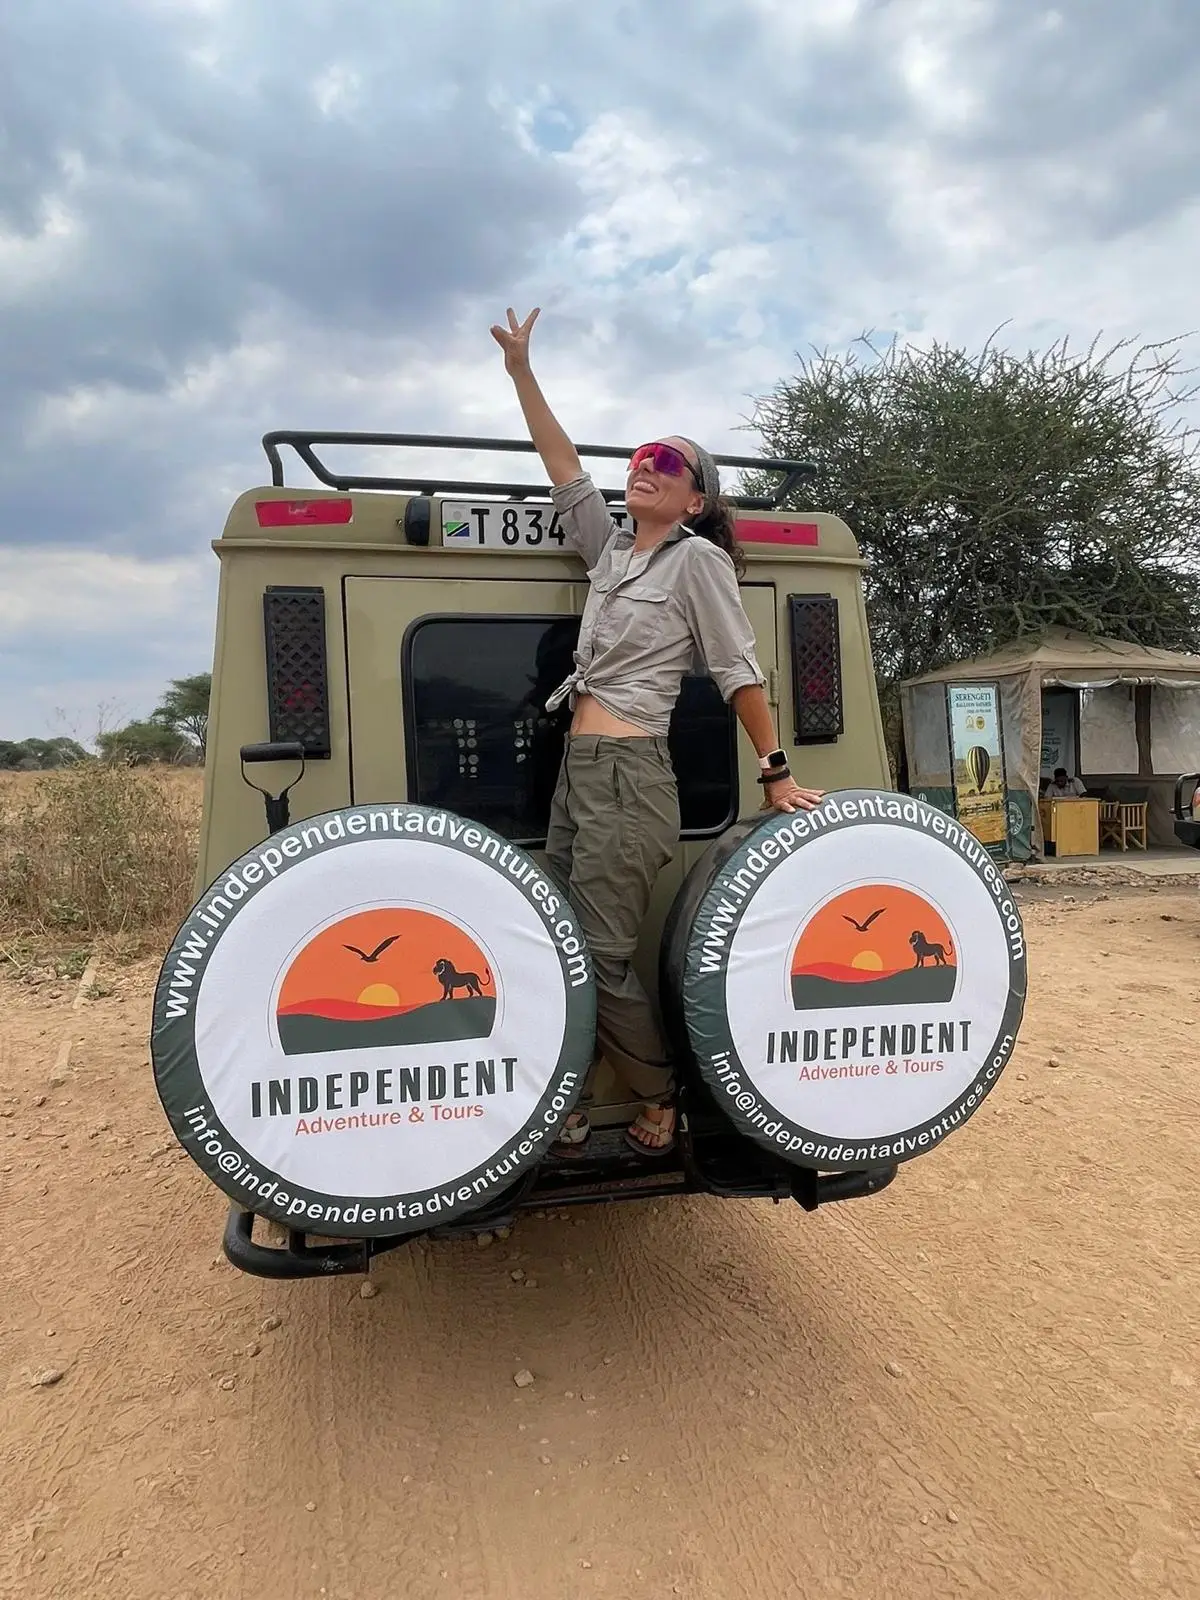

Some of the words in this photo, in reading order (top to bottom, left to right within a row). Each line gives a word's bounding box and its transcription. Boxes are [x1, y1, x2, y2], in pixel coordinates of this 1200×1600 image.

[470, 508, 490, 545] T
[501, 508, 566, 546] 834
[955, 692, 991, 701] SERENGETI
[699, 796, 1025, 974] www.independentadventures.com
[165, 807, 588, 1020] www.independentadventures.com
[766, 1020, 972, 1064] INDEPENDENT
[251, 1057, 518, 1118] INDEPENDENT
[799, 1062, 880, 1081] Adventure
[884, 1059, 898, 1075] &
[903, 1058, 944, 1074] Tours
[295, 1110, 401, 1137] Adventure
[408, 1106, 424, 1123] &
[430, 1103, 484, 1121] Tours
[711, 1034, 1014, 1162] info@independentadventures.com
[184, 1070, 578, 1224] info@independentadventures.com
